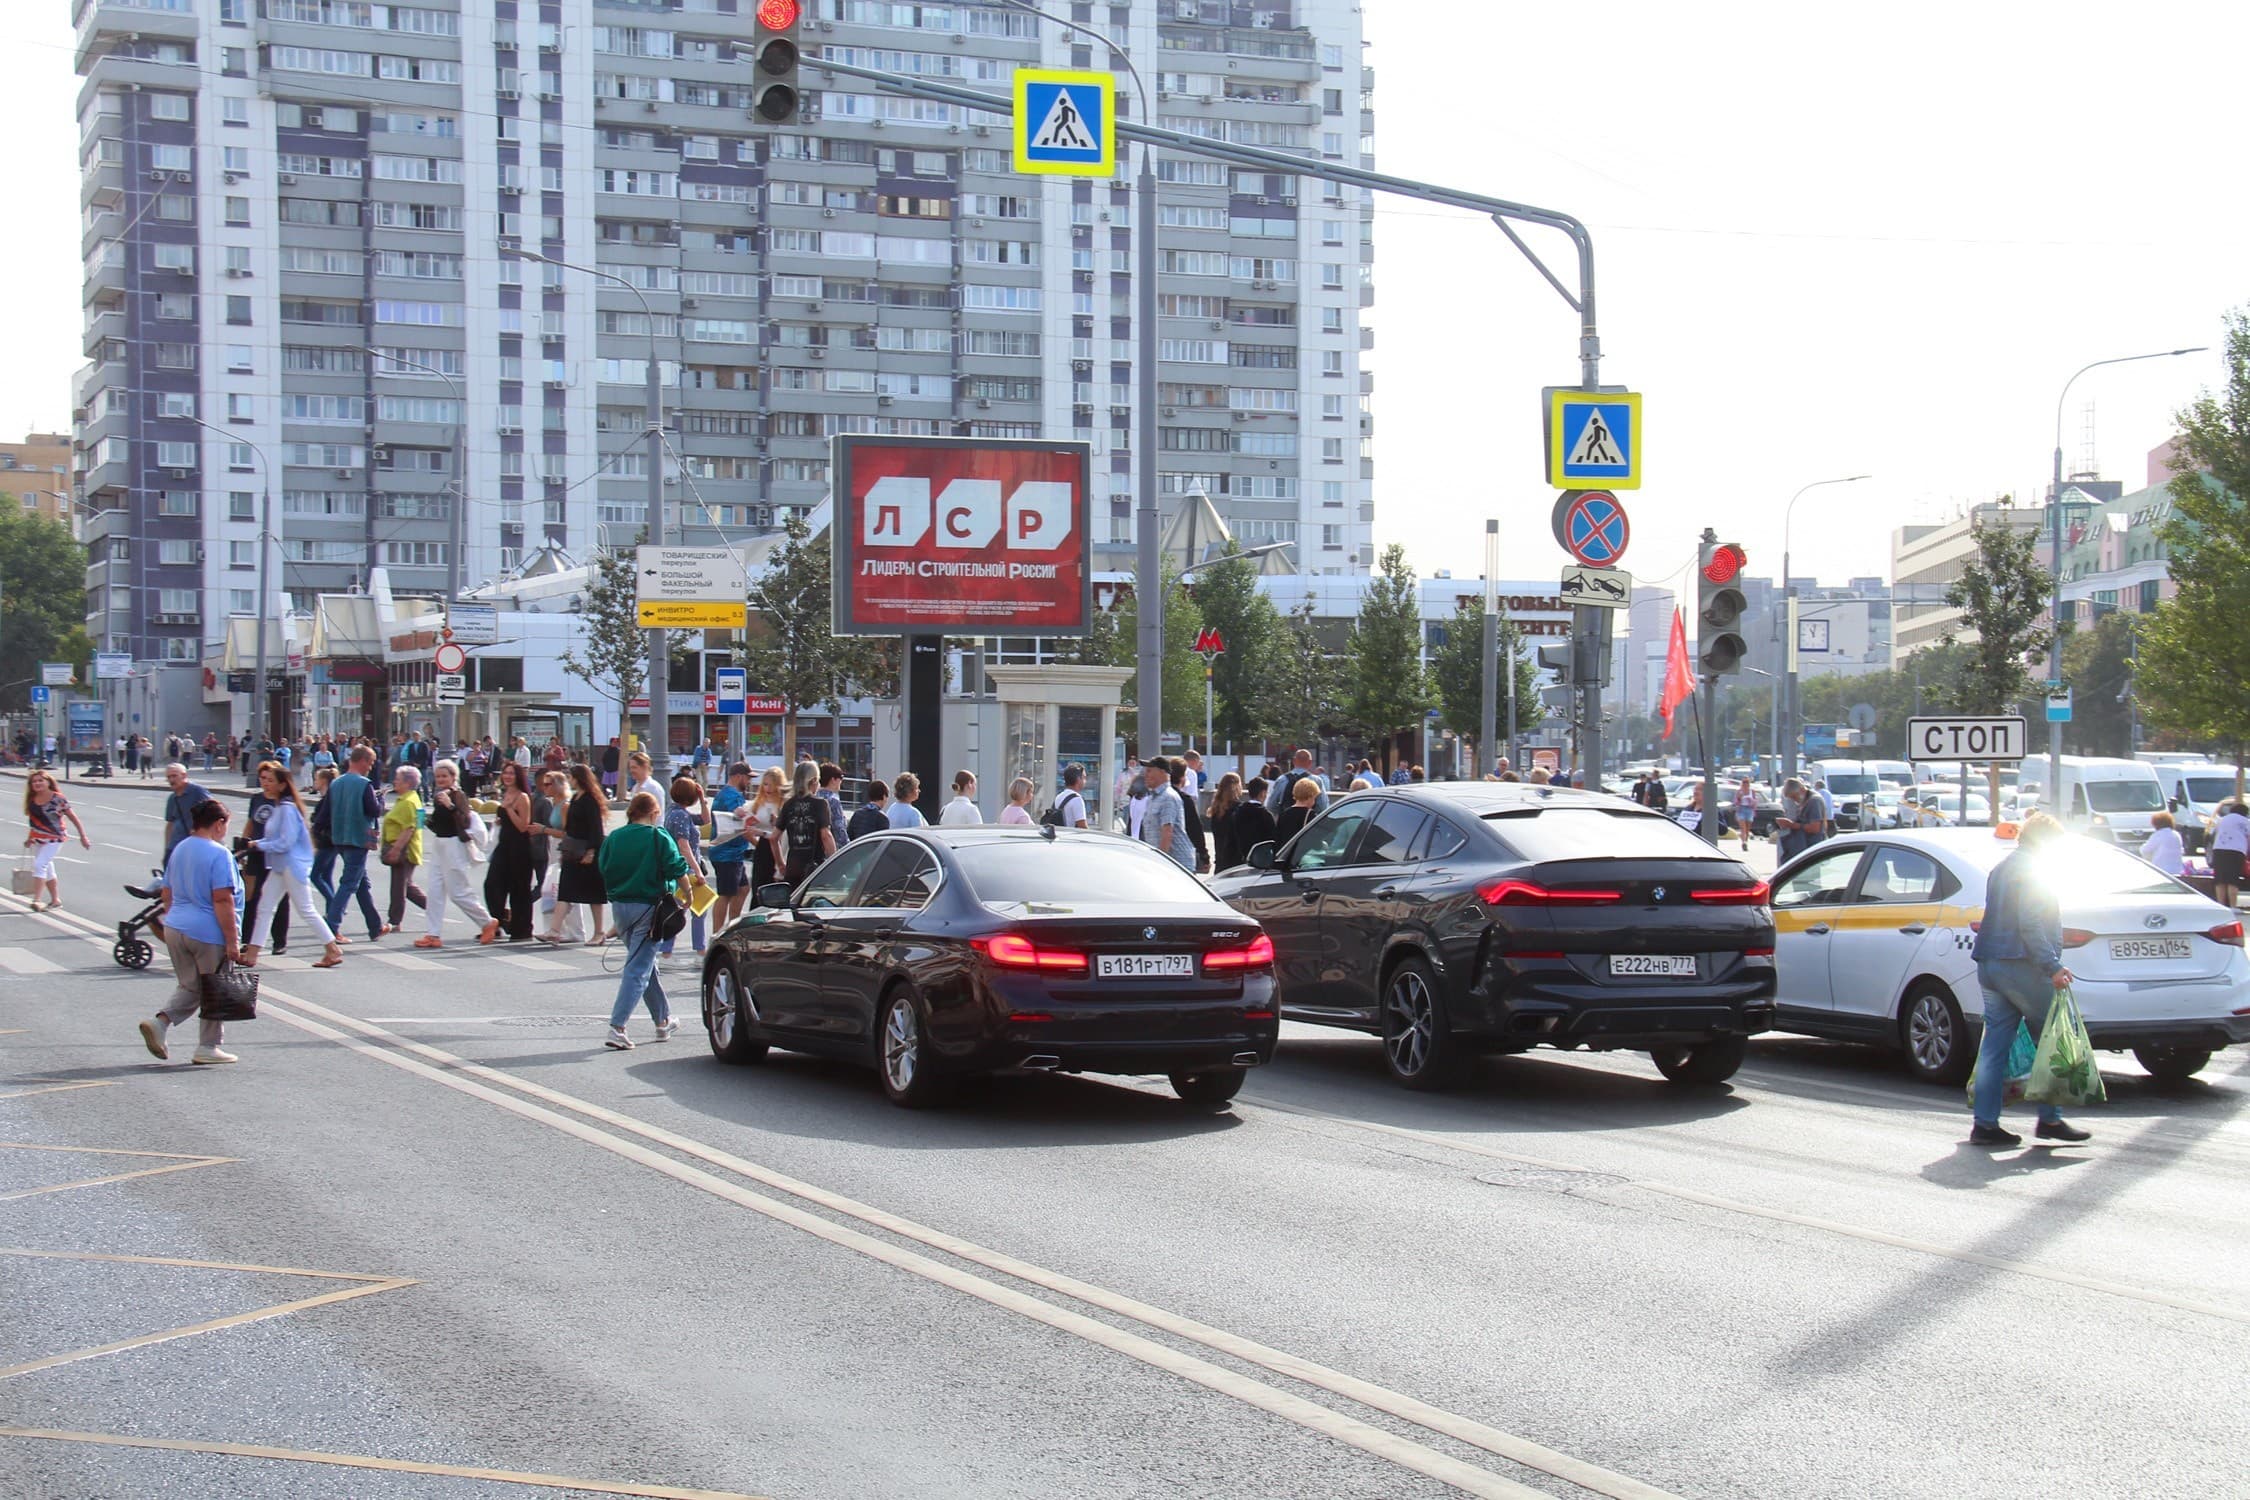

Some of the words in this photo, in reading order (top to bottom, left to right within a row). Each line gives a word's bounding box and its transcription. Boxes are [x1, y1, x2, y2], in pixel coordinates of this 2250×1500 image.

[872, 505, 1043, 540] ЛСР
[661, 551, 728, 560] ТОВАРИЩЕСКИЙ
[661, 571, 703, 579] БОЛЬШОЙ
[861, 559, 915, 576] ЛИДЕРЫ
[918, 560, 1006, 578] СТРОИТЕЛЬНОЙ
[661, 580, 713, 588] ФАКЕЛЬНЫЙ
[1925, 725, 2009, 754] СТОП
[1103, 957, 1162, 974] В181РТ
[1166, 956, 1188, 969] 797
[1615, 957, 1670, 973] Е222НВ
[1671, 957, 1692, 969] 777
